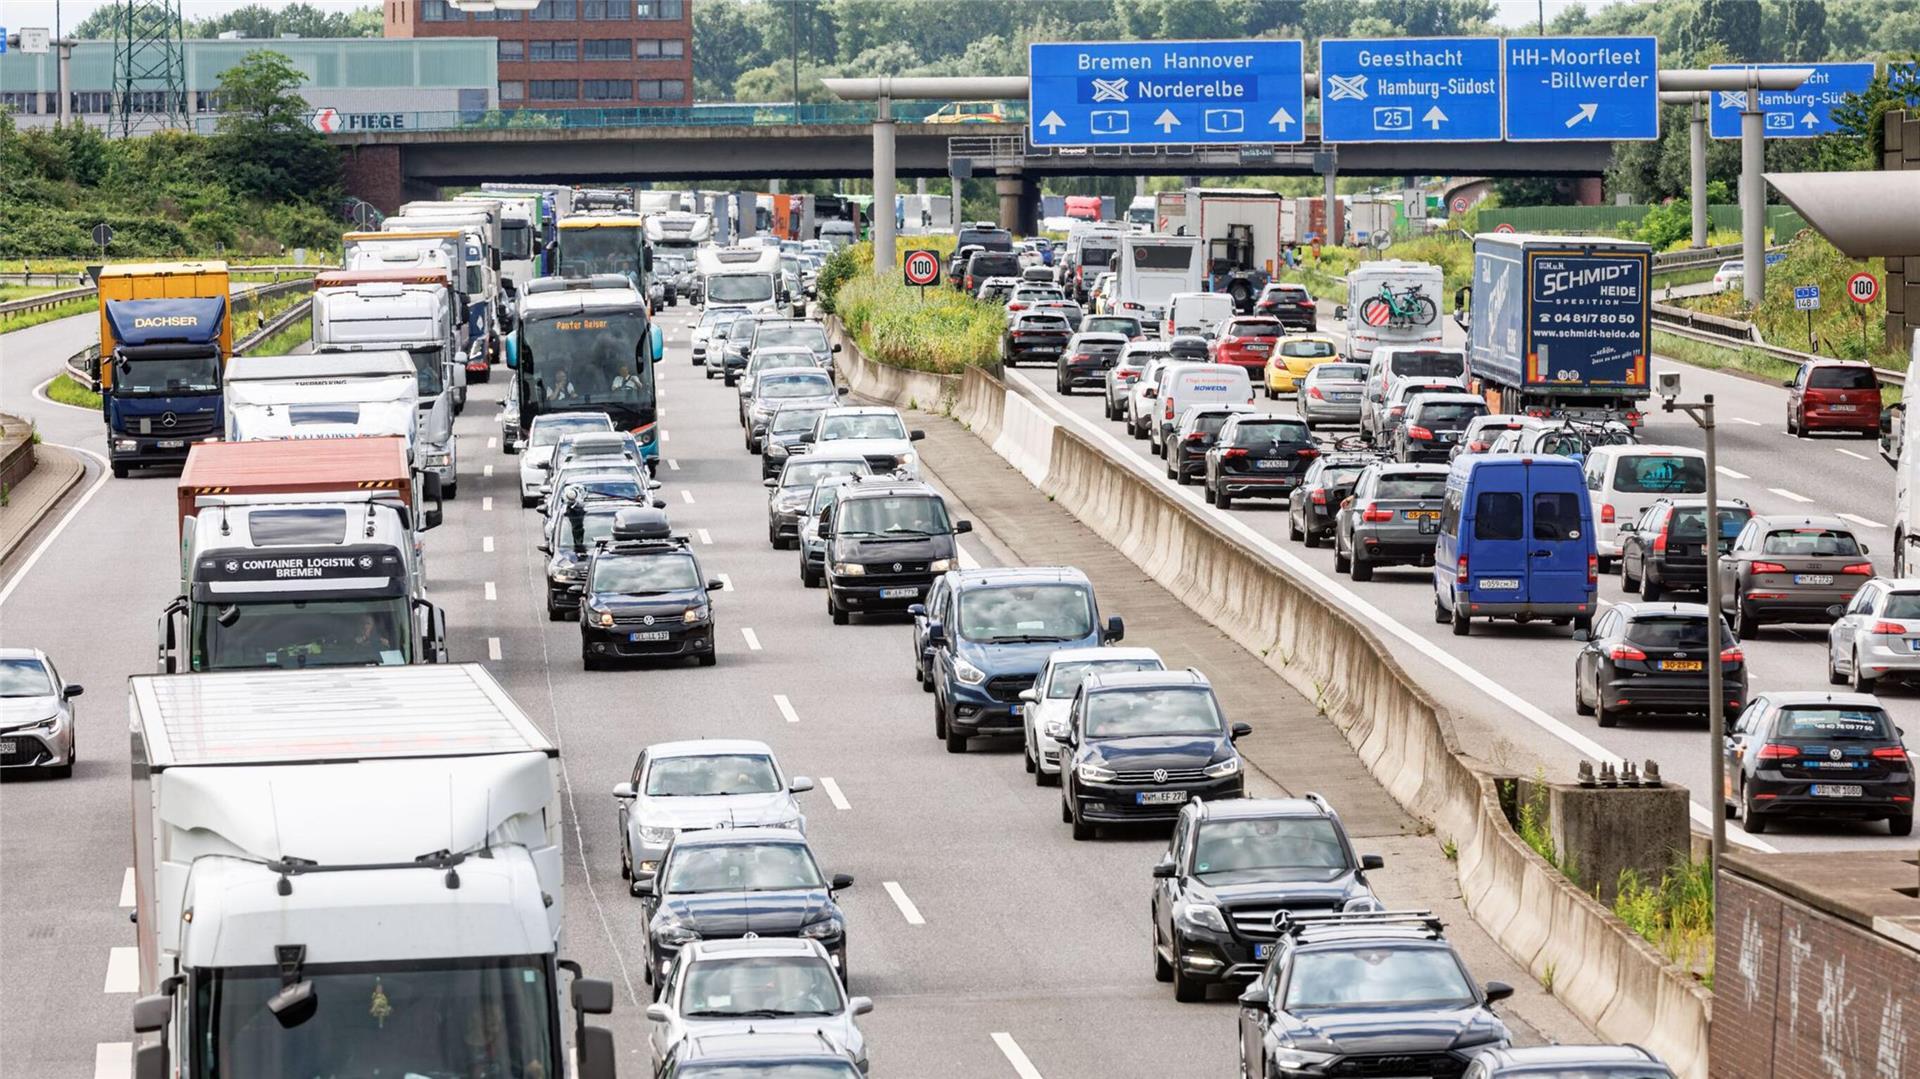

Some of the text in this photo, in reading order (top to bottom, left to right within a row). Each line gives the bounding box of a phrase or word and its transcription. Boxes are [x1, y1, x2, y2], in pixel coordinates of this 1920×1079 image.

[1078, 52, 1254, 70] Bremen Hannover
[1358, 49, 1463, 67] Geesthacht
[1512, 48, 1641, 65] HH-Moorfleet
[1541, 71, 1649, 88] -Billwerder
[1138, 81, 1244, 98] Norderelbe
[1378, 78, 1496, 99] Hamburg-Südost
[349, 114, 404, 129] FIEGE
[1106, 115, 1114, 129] 1
[1221, 114, 1229, 128] 1
[1383, 112, 1402, 126] 25
[1773, 115, 1787, 127] 25
[912, 260, 931, 275] 100
[1543, 264, 1633, 295] SCHMIDT
[1600, 285, 1637, 297] HEIDE
[1853, 280, 1873, 295] 100
[134, 316, 198, 328] DACHSER
[1554, 313, 1635, 324] 04 81/7 80 50
[1533, 328, 1640, 338] www.schmidt-heide.de
[242, 558, 355, 570] CONTAINER LOGISTIK
[276, 568, 322, 578] BREMEN
[1161, 792, 1170, 801] EF
[1172, 791, 1186, 801] 270
